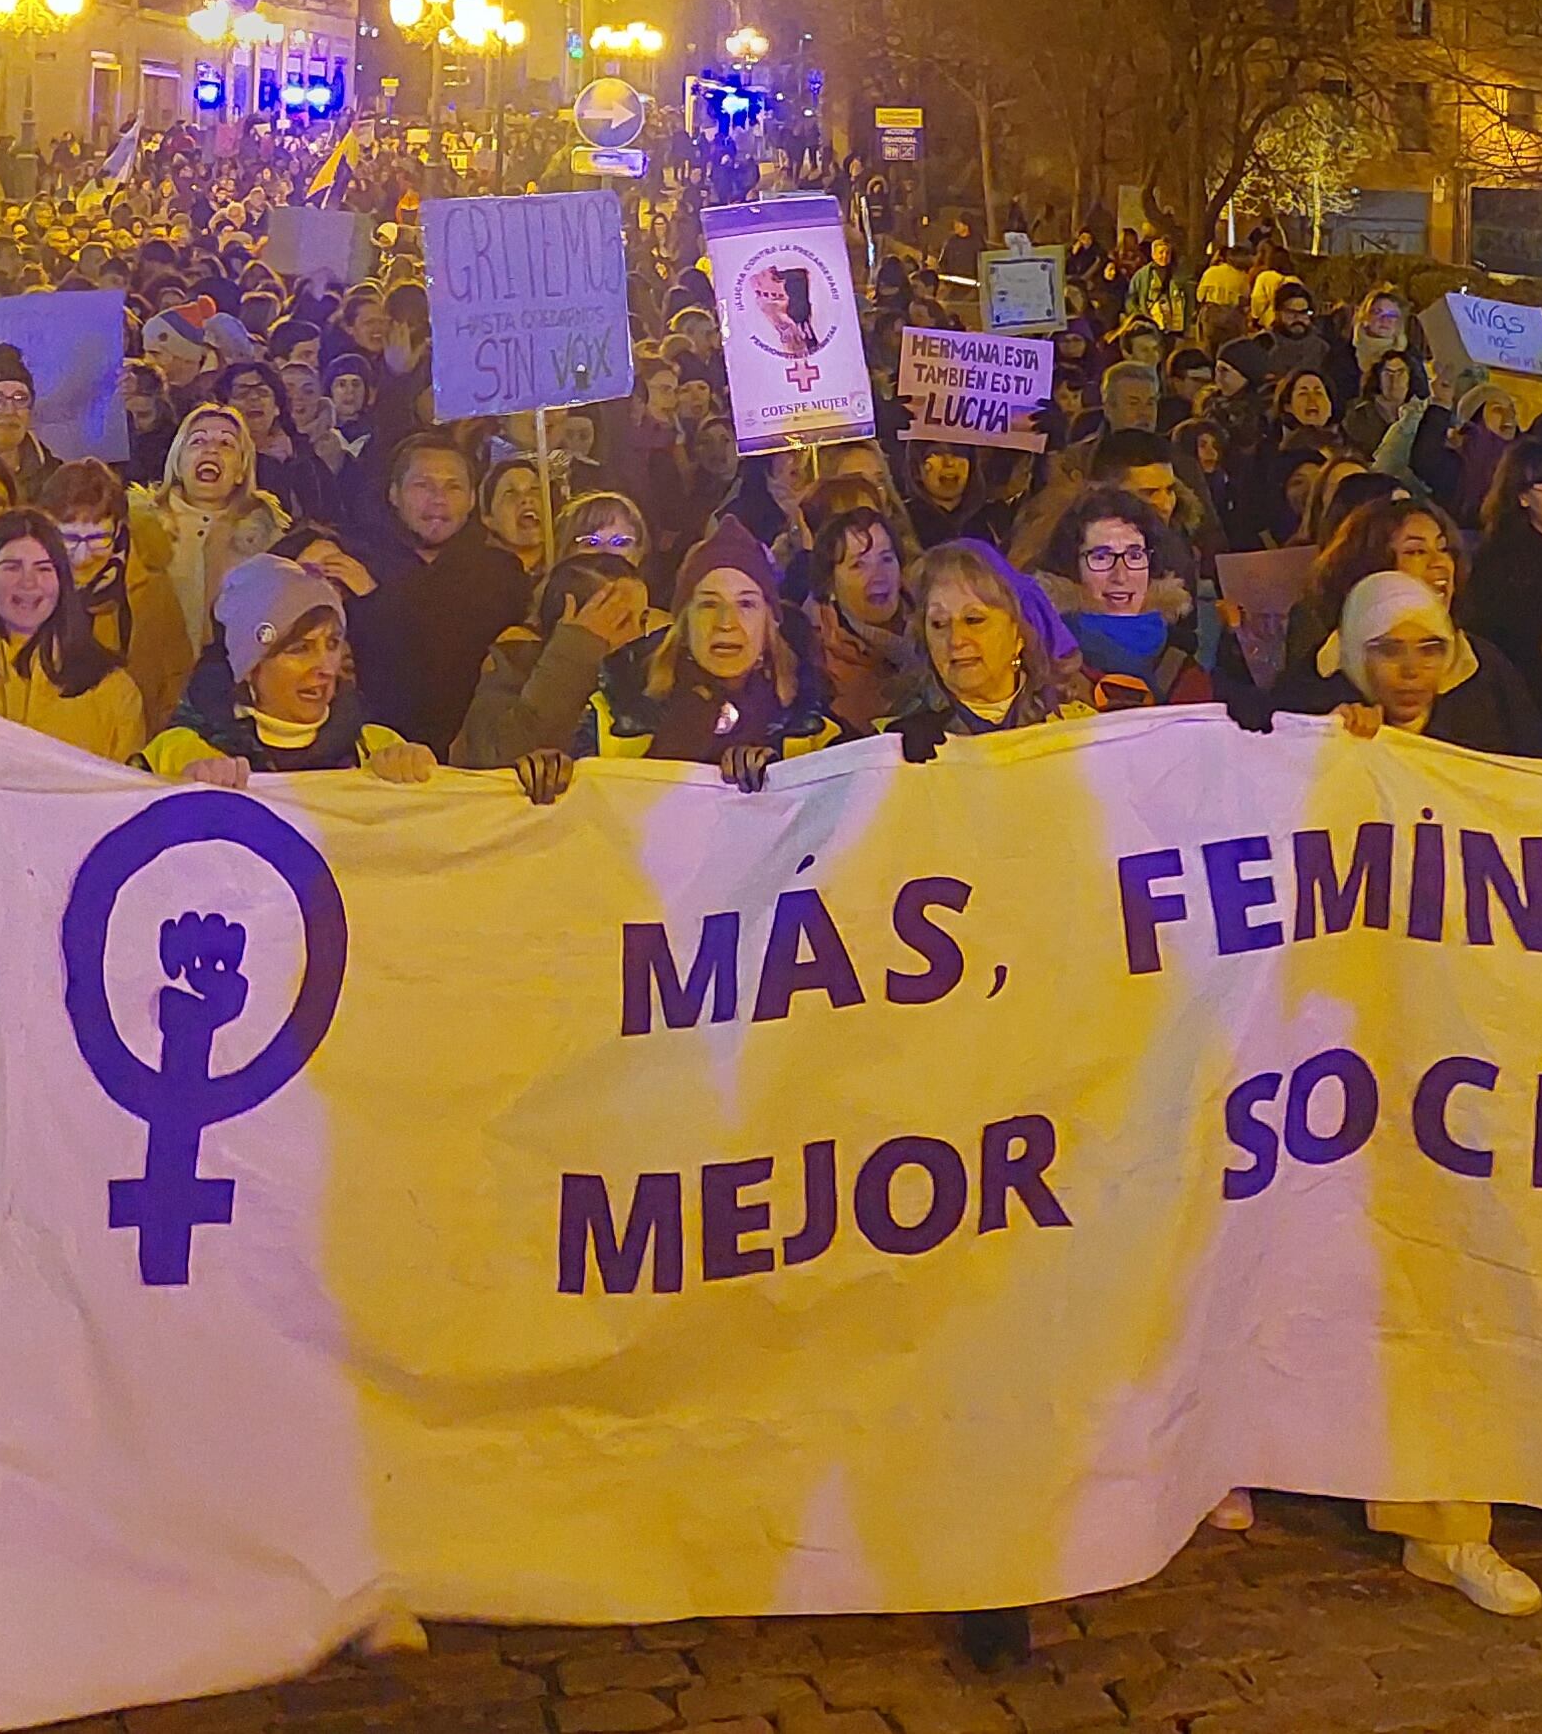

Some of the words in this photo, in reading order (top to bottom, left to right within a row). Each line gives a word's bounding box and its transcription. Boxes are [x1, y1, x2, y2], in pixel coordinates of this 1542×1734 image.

[443, 196, 623, 302] GRITEMOS
[473, 332, 536, 402] SIN
[911, 334, 1003, 368] HERMANA,
[1004, 346, 1039, 371] ESTA
[913, 363, 988, 391] TAMBIÉN
[990, 372, 1011, 394] ES
[1014, 375, 1034, 395] TU
[761, 401, 808, 418] COESPE
[810, 396, 849, 411] MUJER
[924, 392, 1009, 433] LUCHA
[621, 855, 1008, 1037] MÁS,
[557, 1114, 1073, 1295] MEJOR
